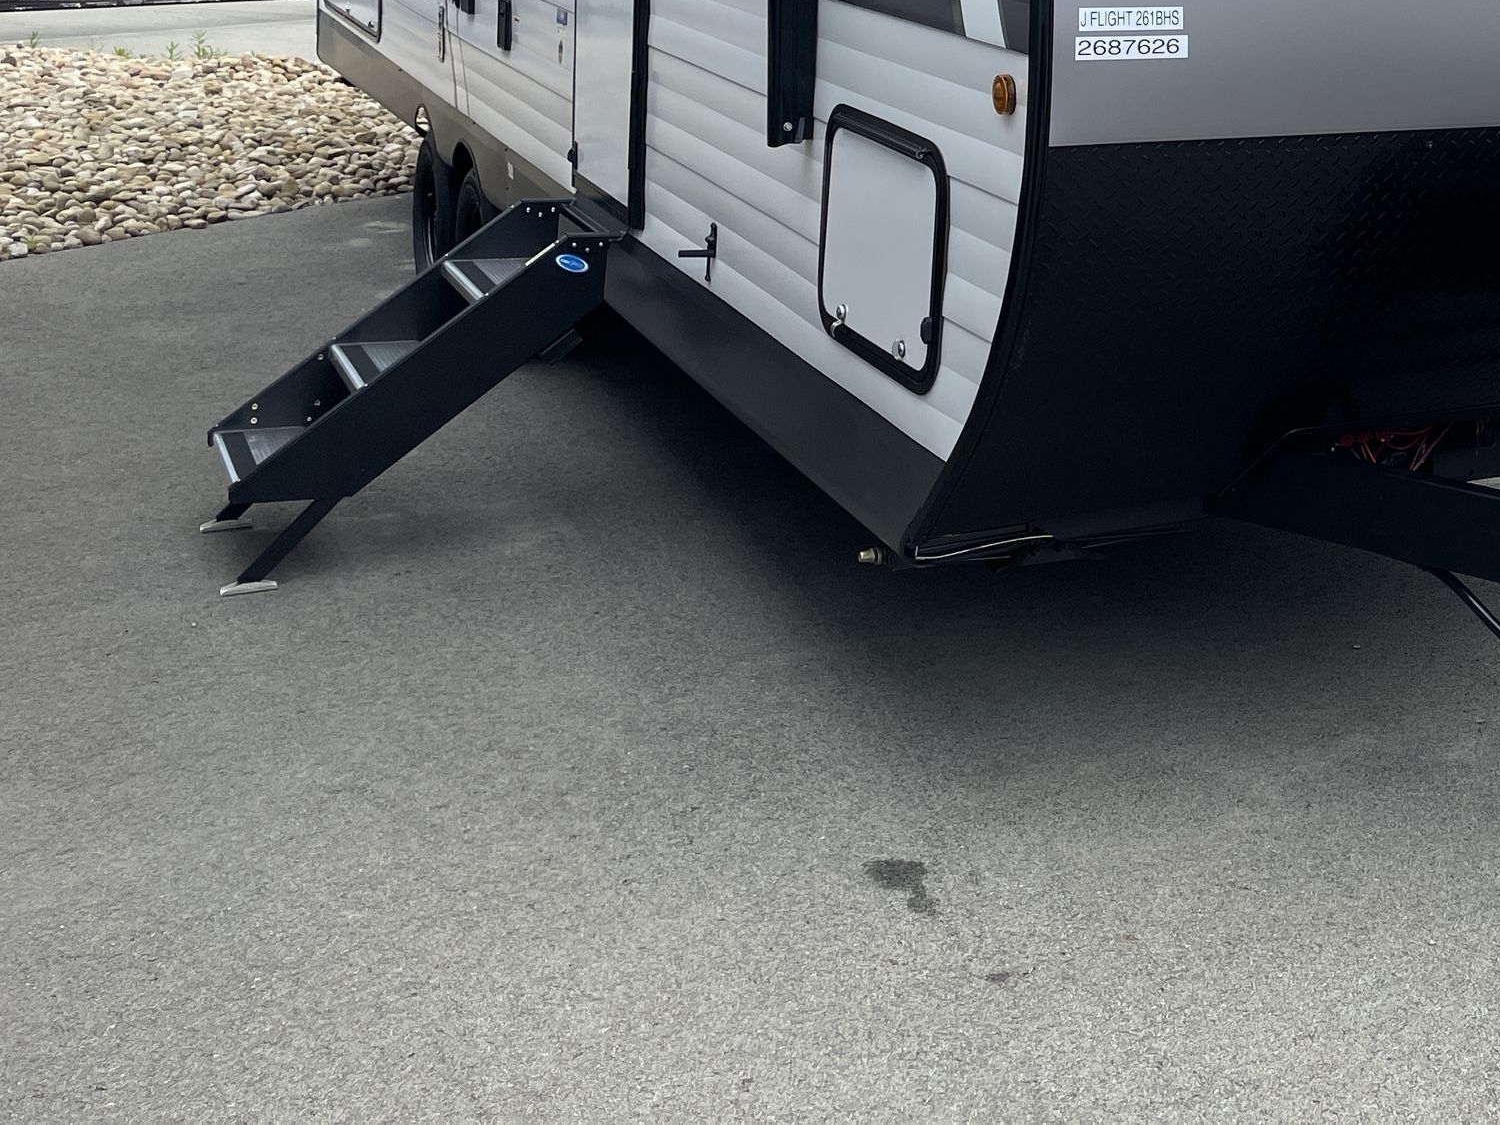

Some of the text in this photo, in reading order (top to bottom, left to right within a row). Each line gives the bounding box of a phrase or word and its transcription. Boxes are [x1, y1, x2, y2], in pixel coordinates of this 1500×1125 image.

[1080, 10, 1180, 27] J FLIGHT 261BHS
[1077, 39, 1180, 56] 2687626
